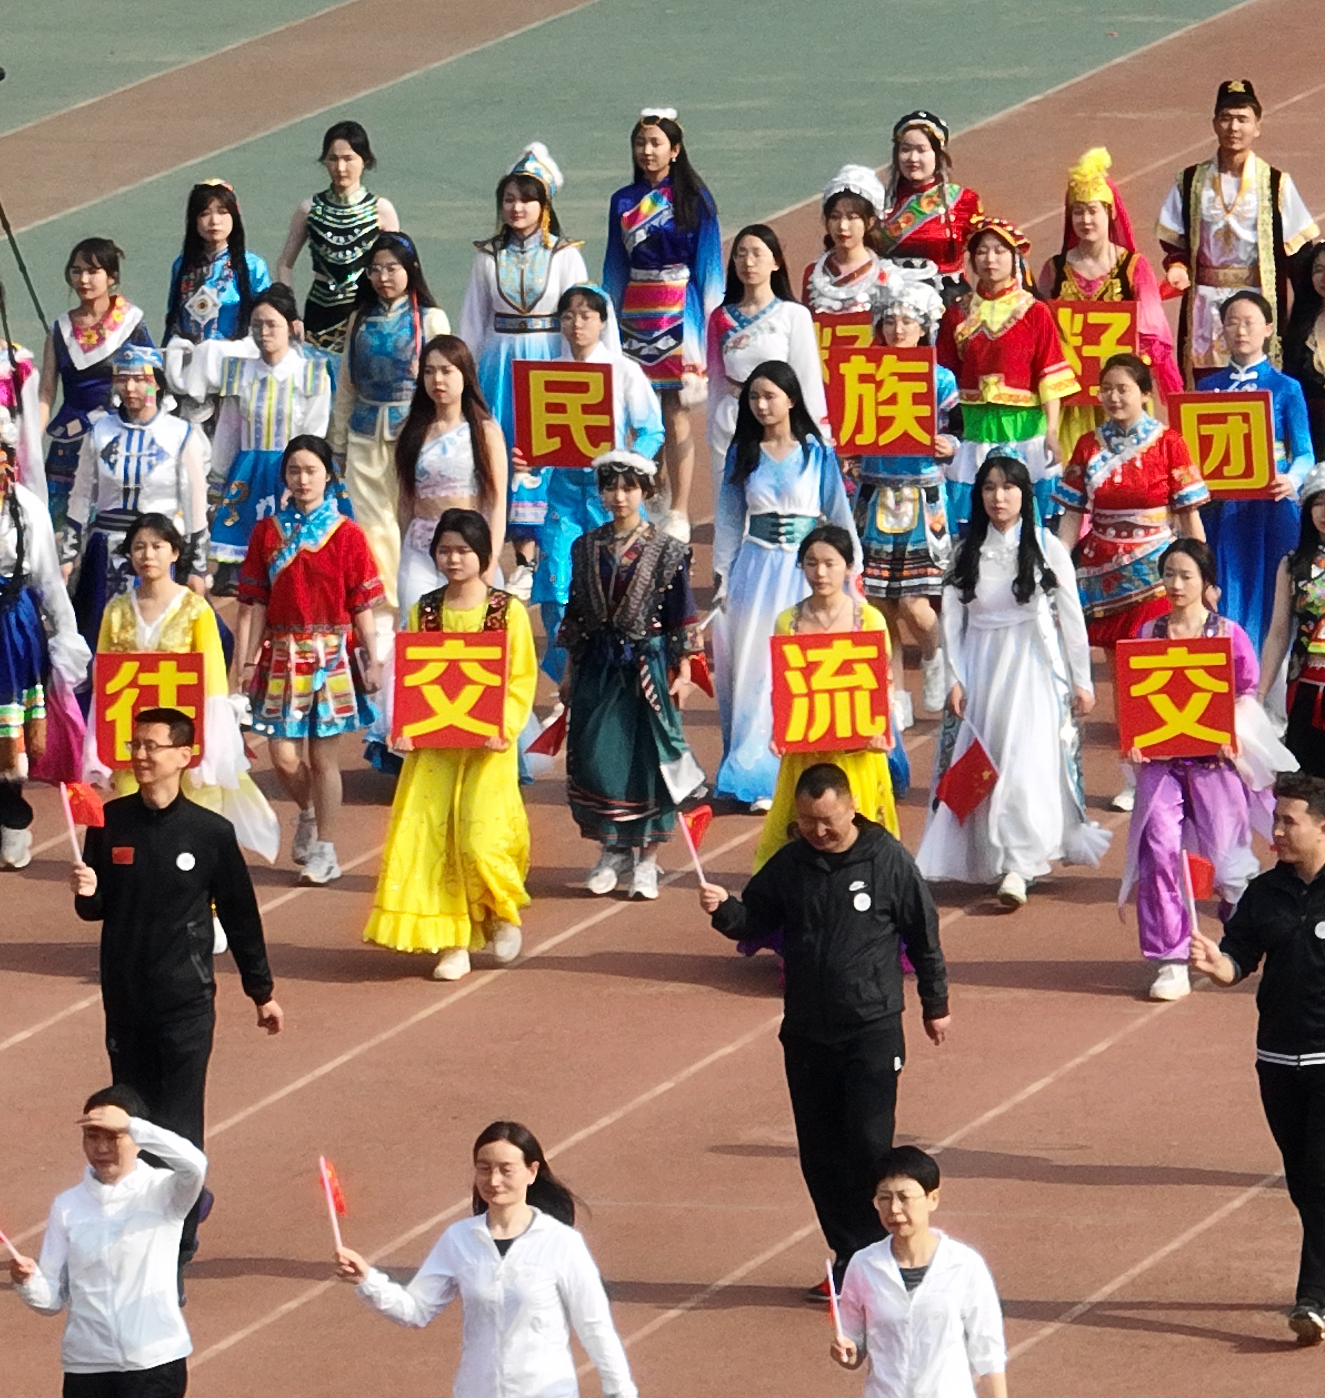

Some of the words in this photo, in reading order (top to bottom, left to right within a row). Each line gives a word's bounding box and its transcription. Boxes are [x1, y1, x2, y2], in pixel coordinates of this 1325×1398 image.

[530, 370, 610, 457] 民
[839, 354, 932, 446] 族
[1180, 401, 1269, 490] 团
[403, 640, 502, 738] 交
[782, 639, 886, 741] 流
[1129, 647, 1232, 748] 交
